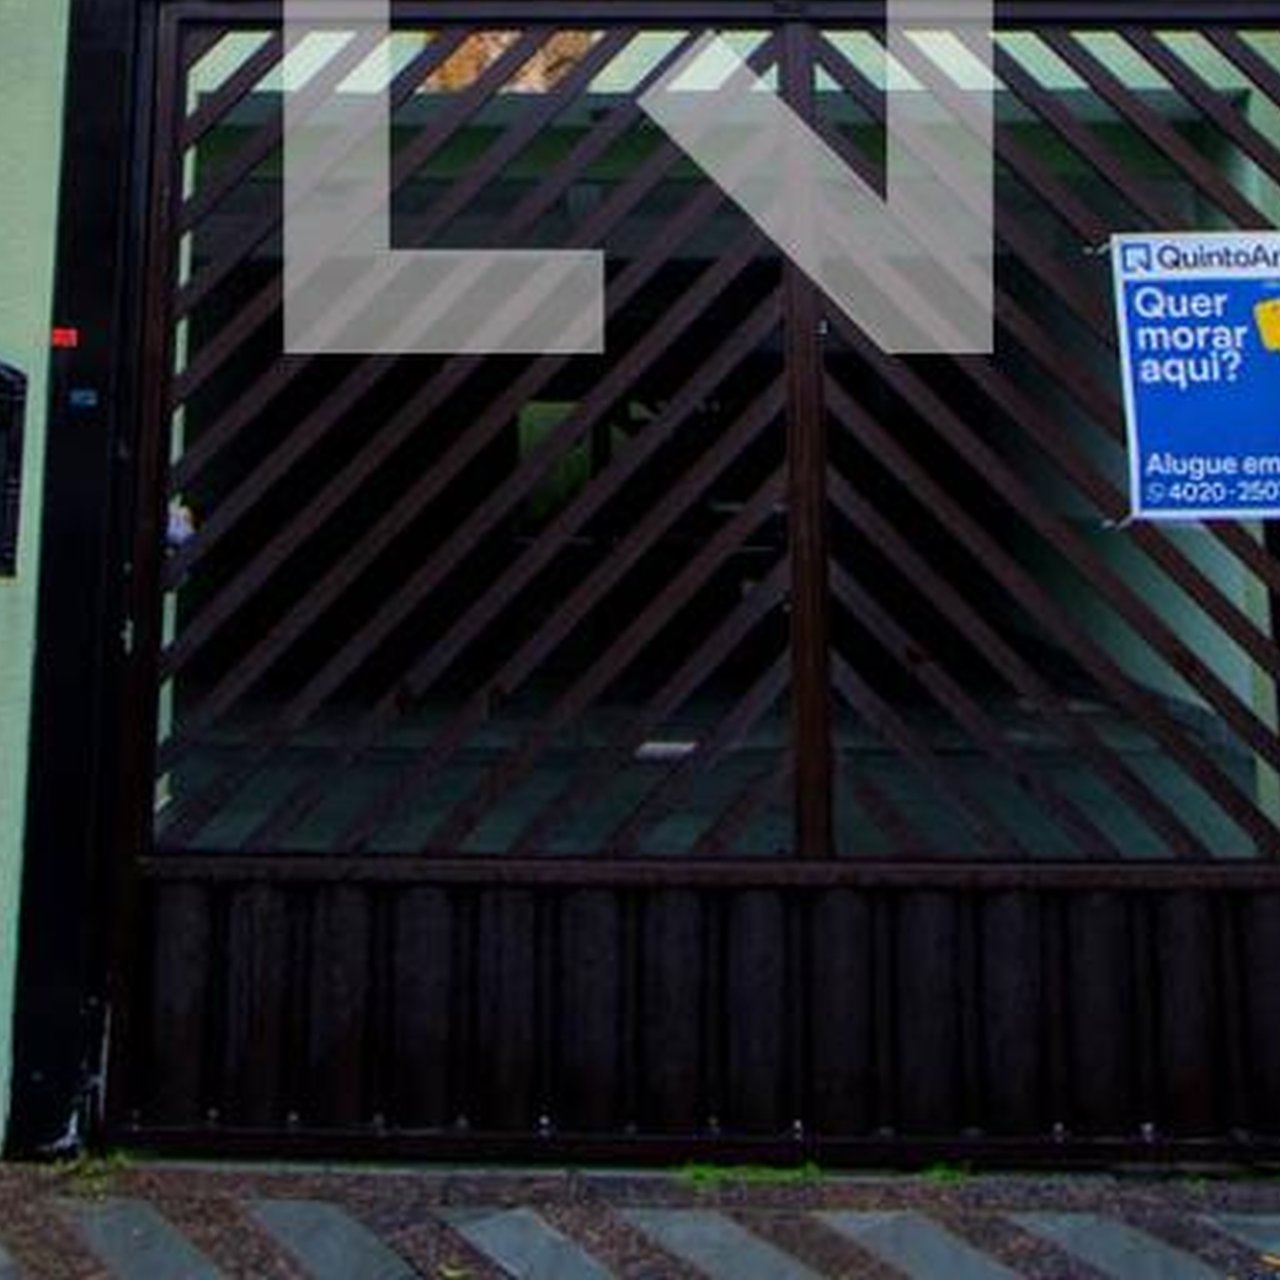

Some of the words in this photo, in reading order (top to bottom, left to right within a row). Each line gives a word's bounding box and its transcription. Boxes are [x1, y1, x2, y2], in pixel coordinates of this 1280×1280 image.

[1134, 286, 1228, 318] Quer
[1137, 325, 1248, 350] morar
[1141, 350, 1241, 392] aqui?
[1146, 453, 1239, 480] Alugue
